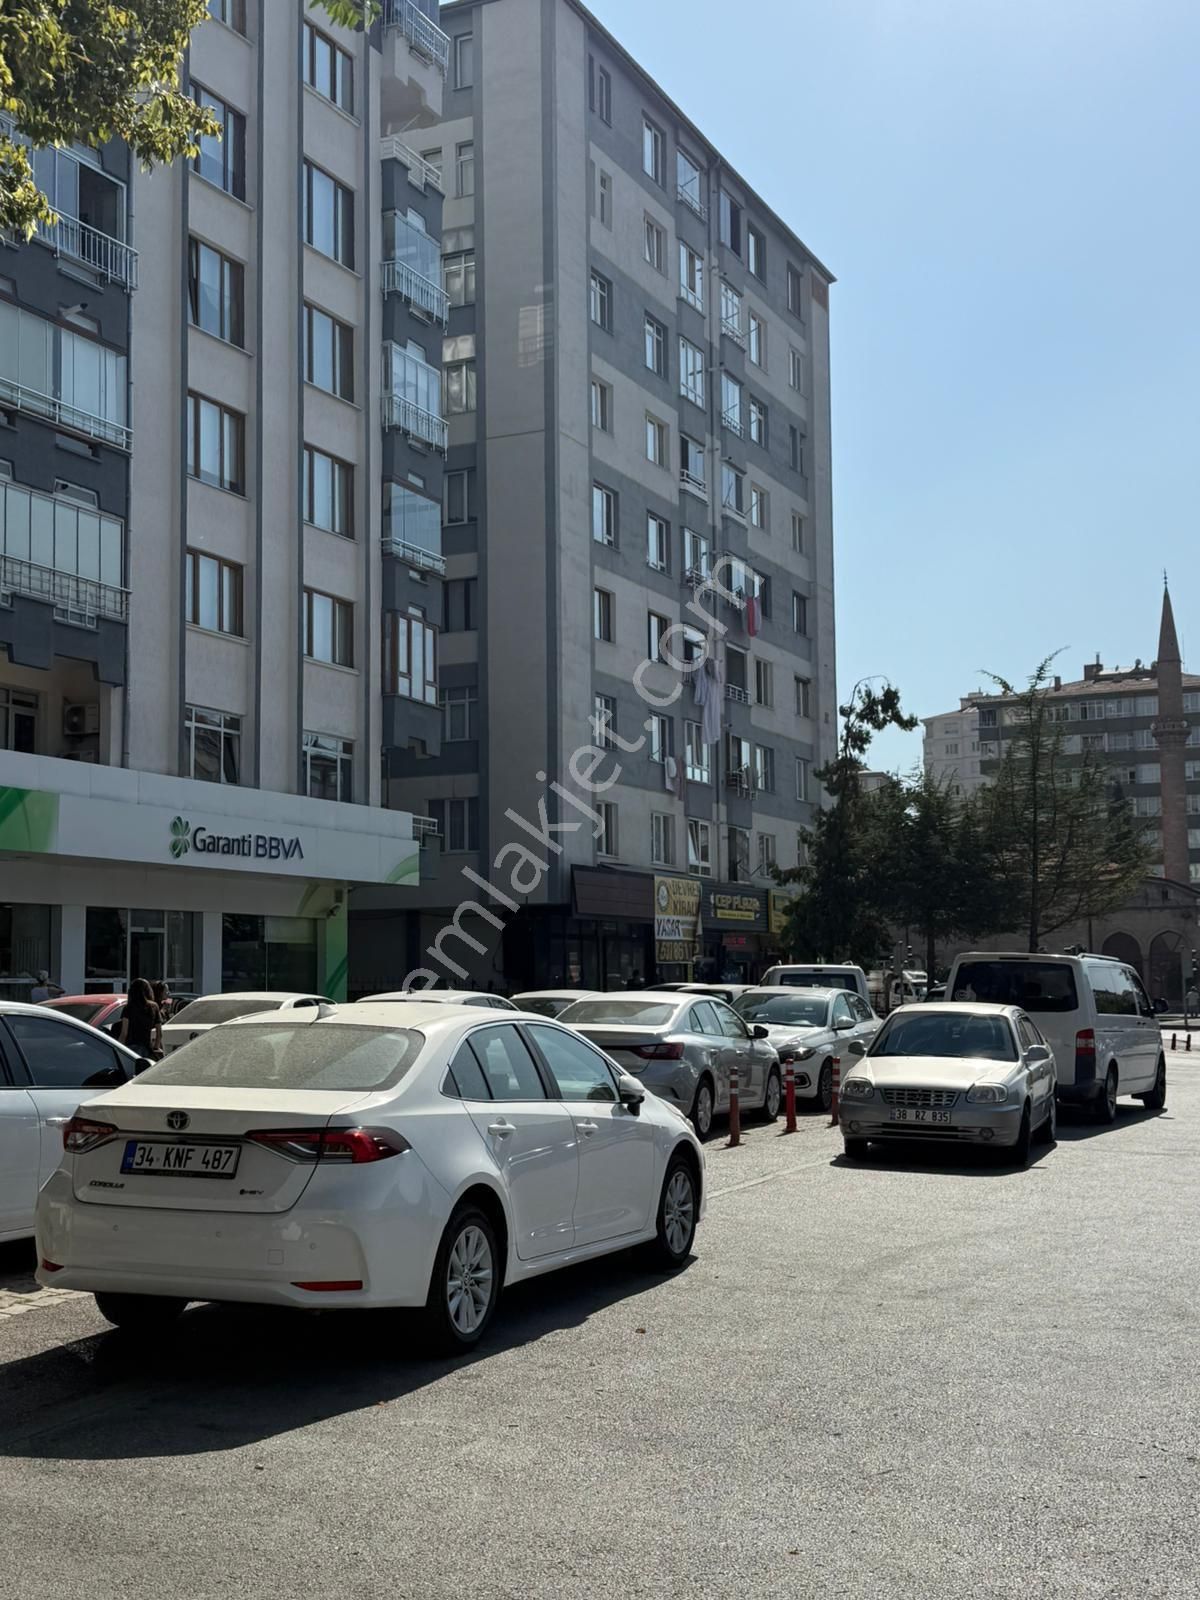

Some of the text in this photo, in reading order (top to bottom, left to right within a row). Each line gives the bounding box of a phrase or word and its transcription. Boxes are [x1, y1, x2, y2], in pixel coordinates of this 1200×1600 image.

[193, 827, 304, 860] Garanti BBVA
[896, 1109, 949, 1122] 38 RZ 835
[135, 1147, 233, 1171] 34 KNF 487
